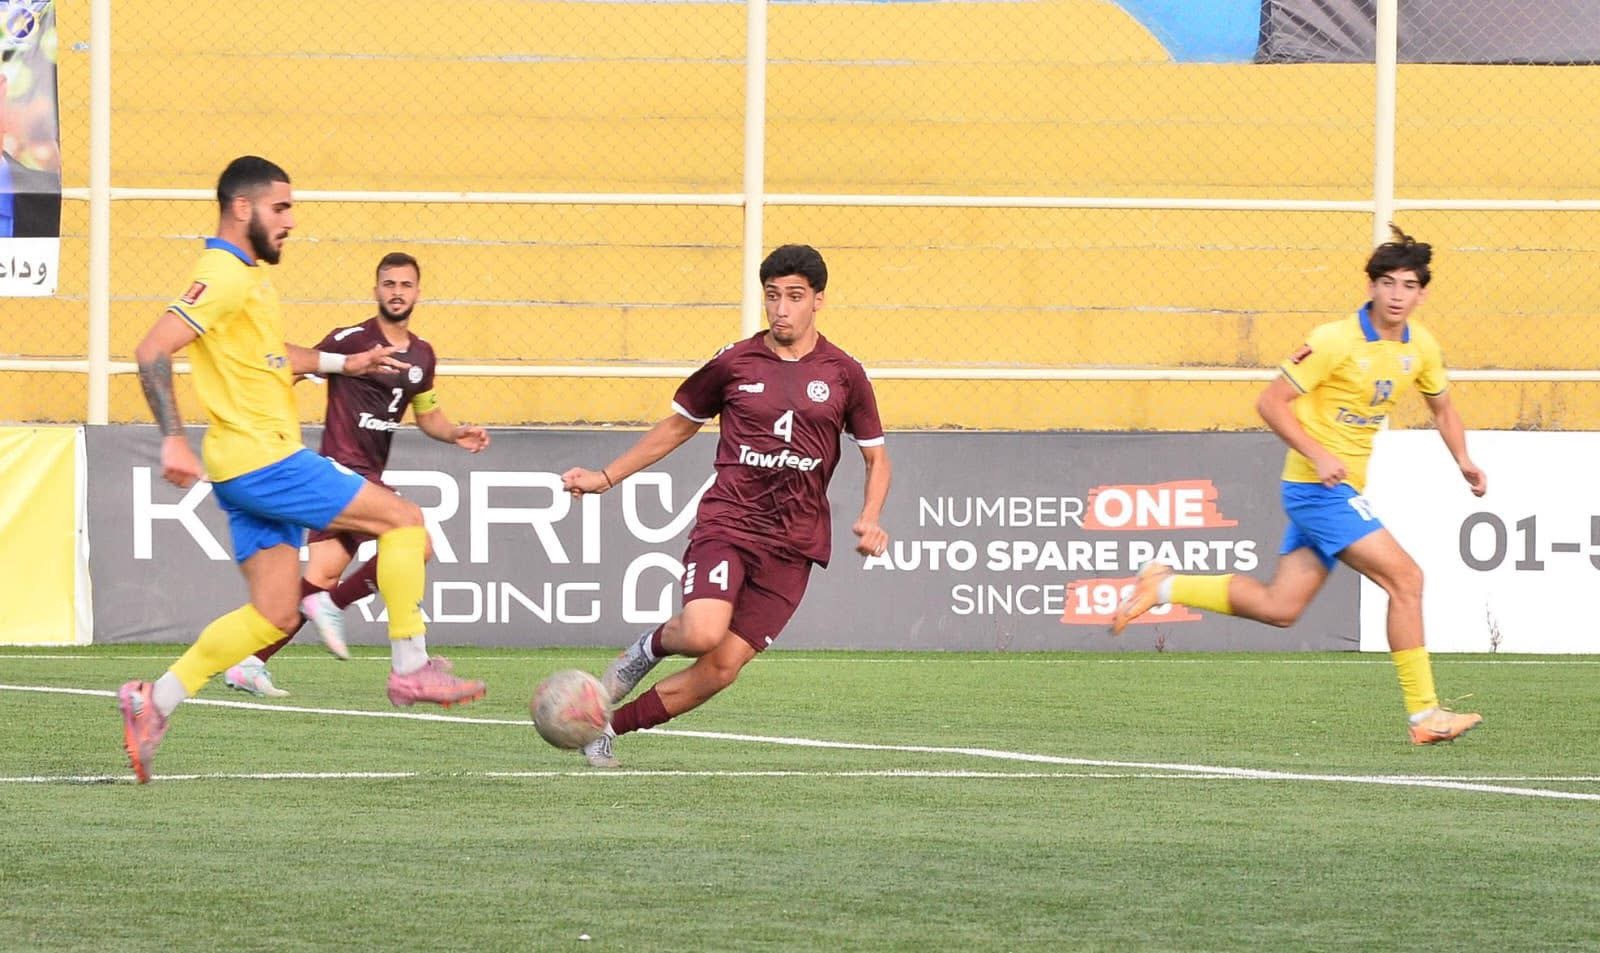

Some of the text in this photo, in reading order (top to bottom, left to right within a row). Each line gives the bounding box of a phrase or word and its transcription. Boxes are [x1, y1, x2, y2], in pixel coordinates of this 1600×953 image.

[388, 387, 403, 413] 2
[773, 410, 794, 443] 4
[739, 444, 822, 471] Tawfeer
[132, 466, 601, 564] KRRI
[919, 488, 1204, 528] NUMBER ONE
[862, 540, 1259, 571] AUTO SPARE PARTS
[1458, 511, 1600, 572] 01-
[709, 560, 729, 591] 4
[951, 584, 1173, 615] SINCE 19
